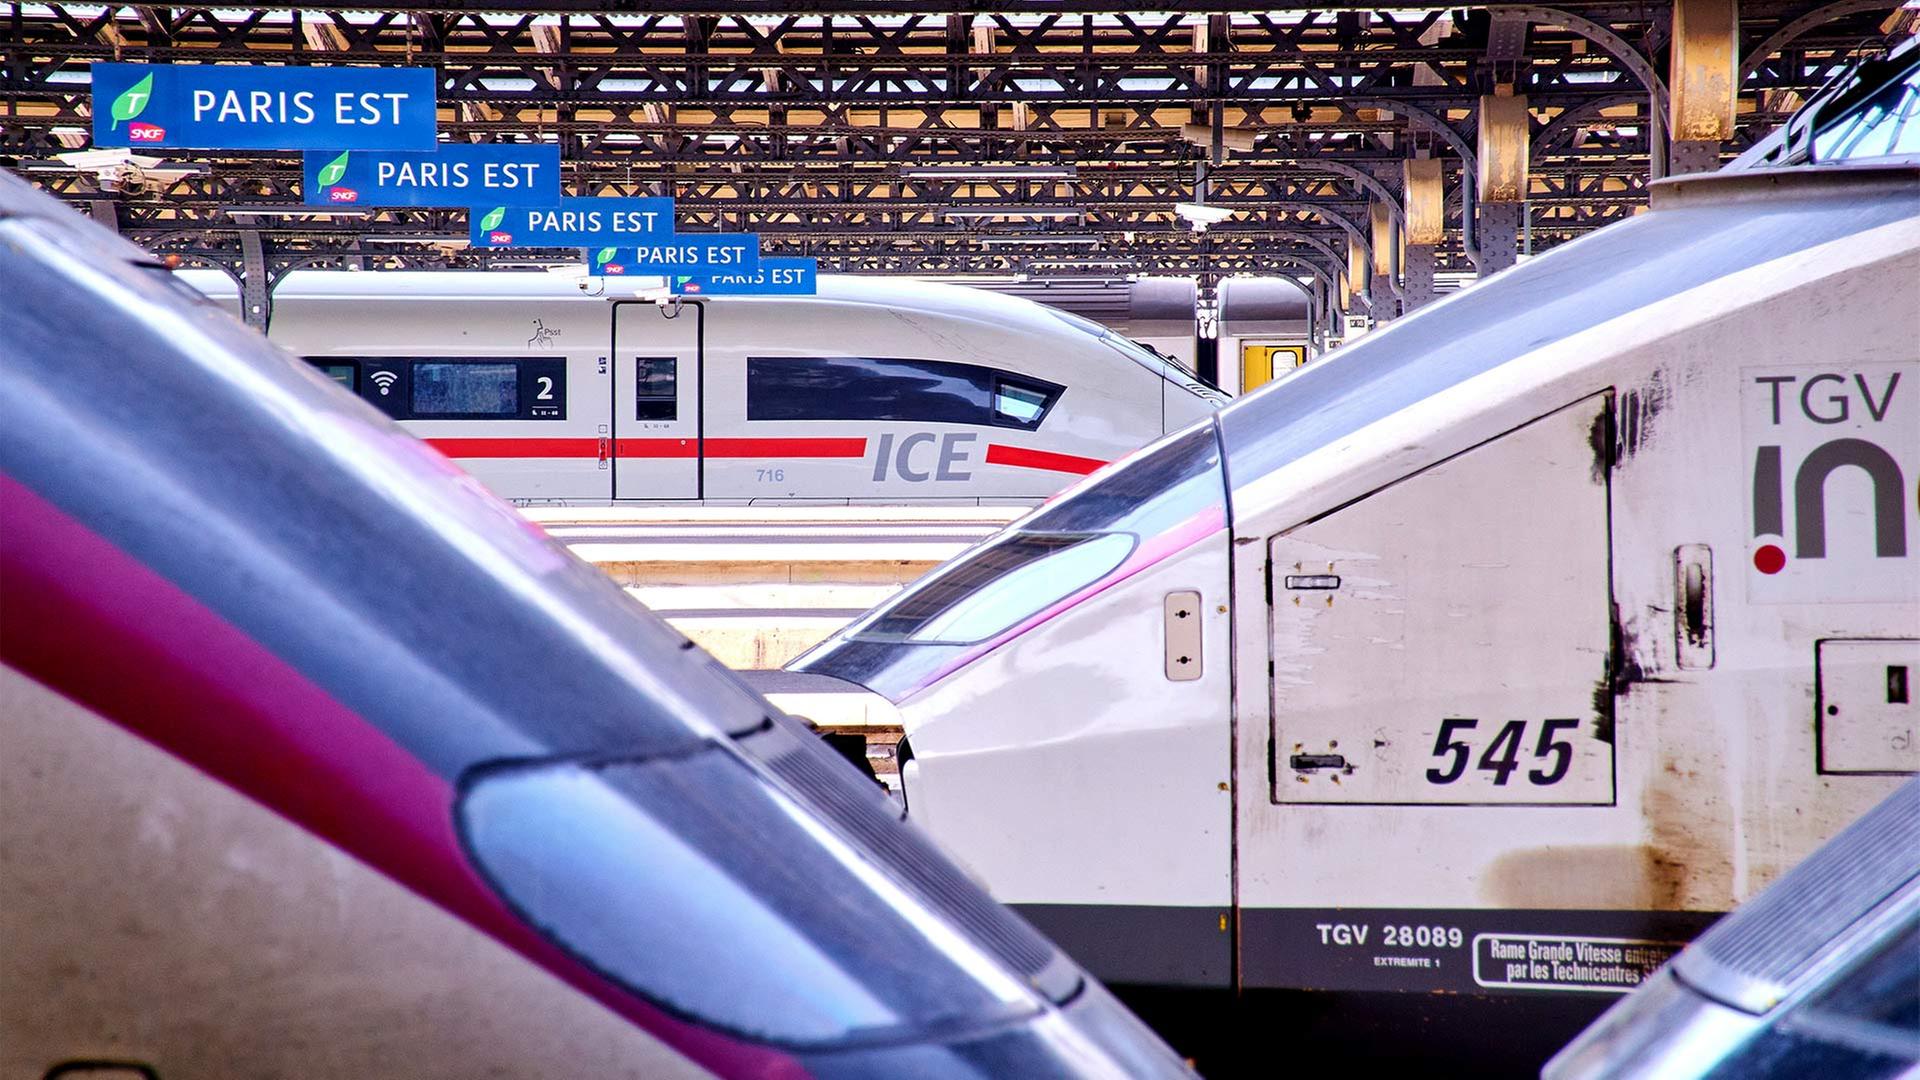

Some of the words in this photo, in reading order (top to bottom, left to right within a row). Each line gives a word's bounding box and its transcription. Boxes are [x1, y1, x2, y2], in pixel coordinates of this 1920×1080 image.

[193, 90, 315, 124] PARIS
[335, 92, 409, 125] EST
[129, 127, 165, 141] SNCF
[378, 162, 469, 187] PARIS
[484, 163, 540, 188] EST
[331, 191, 358, 201] SNCF
[528, 211, 602, 233] PARIS
[612, 212, 658, 233] EST
[637, 246, 698, 264] PARIS
[707, 246, 746, 264] EST
[772, 269, 806, 284] EST
[536, 376, 554, 400] 2
[1755, 372, 1902, 425] TGV
[872, 432, 978, 482] ICE
[755, 468, 785, 483] 716
[1753, 438, 1920, 575] in
[1425, 718, 1580, 786] 545
[1316, 923, 1369, 946] TGV
[1382, 925, 1463, 948] 28089
[1373, 956, 1432, 968] EXTREMITE
[1434, 958, 1441, 968] 1
[1490, 939, 1526, 960] Rame
[1528, 940, 1574, 961] Grande
[1576, 942, 1622, 963] Vitesse
[1506, 963, 1528, 982] par
[1530, 961, 1549, 979] les
[1551, 962, 1640, 984] Technicentres
